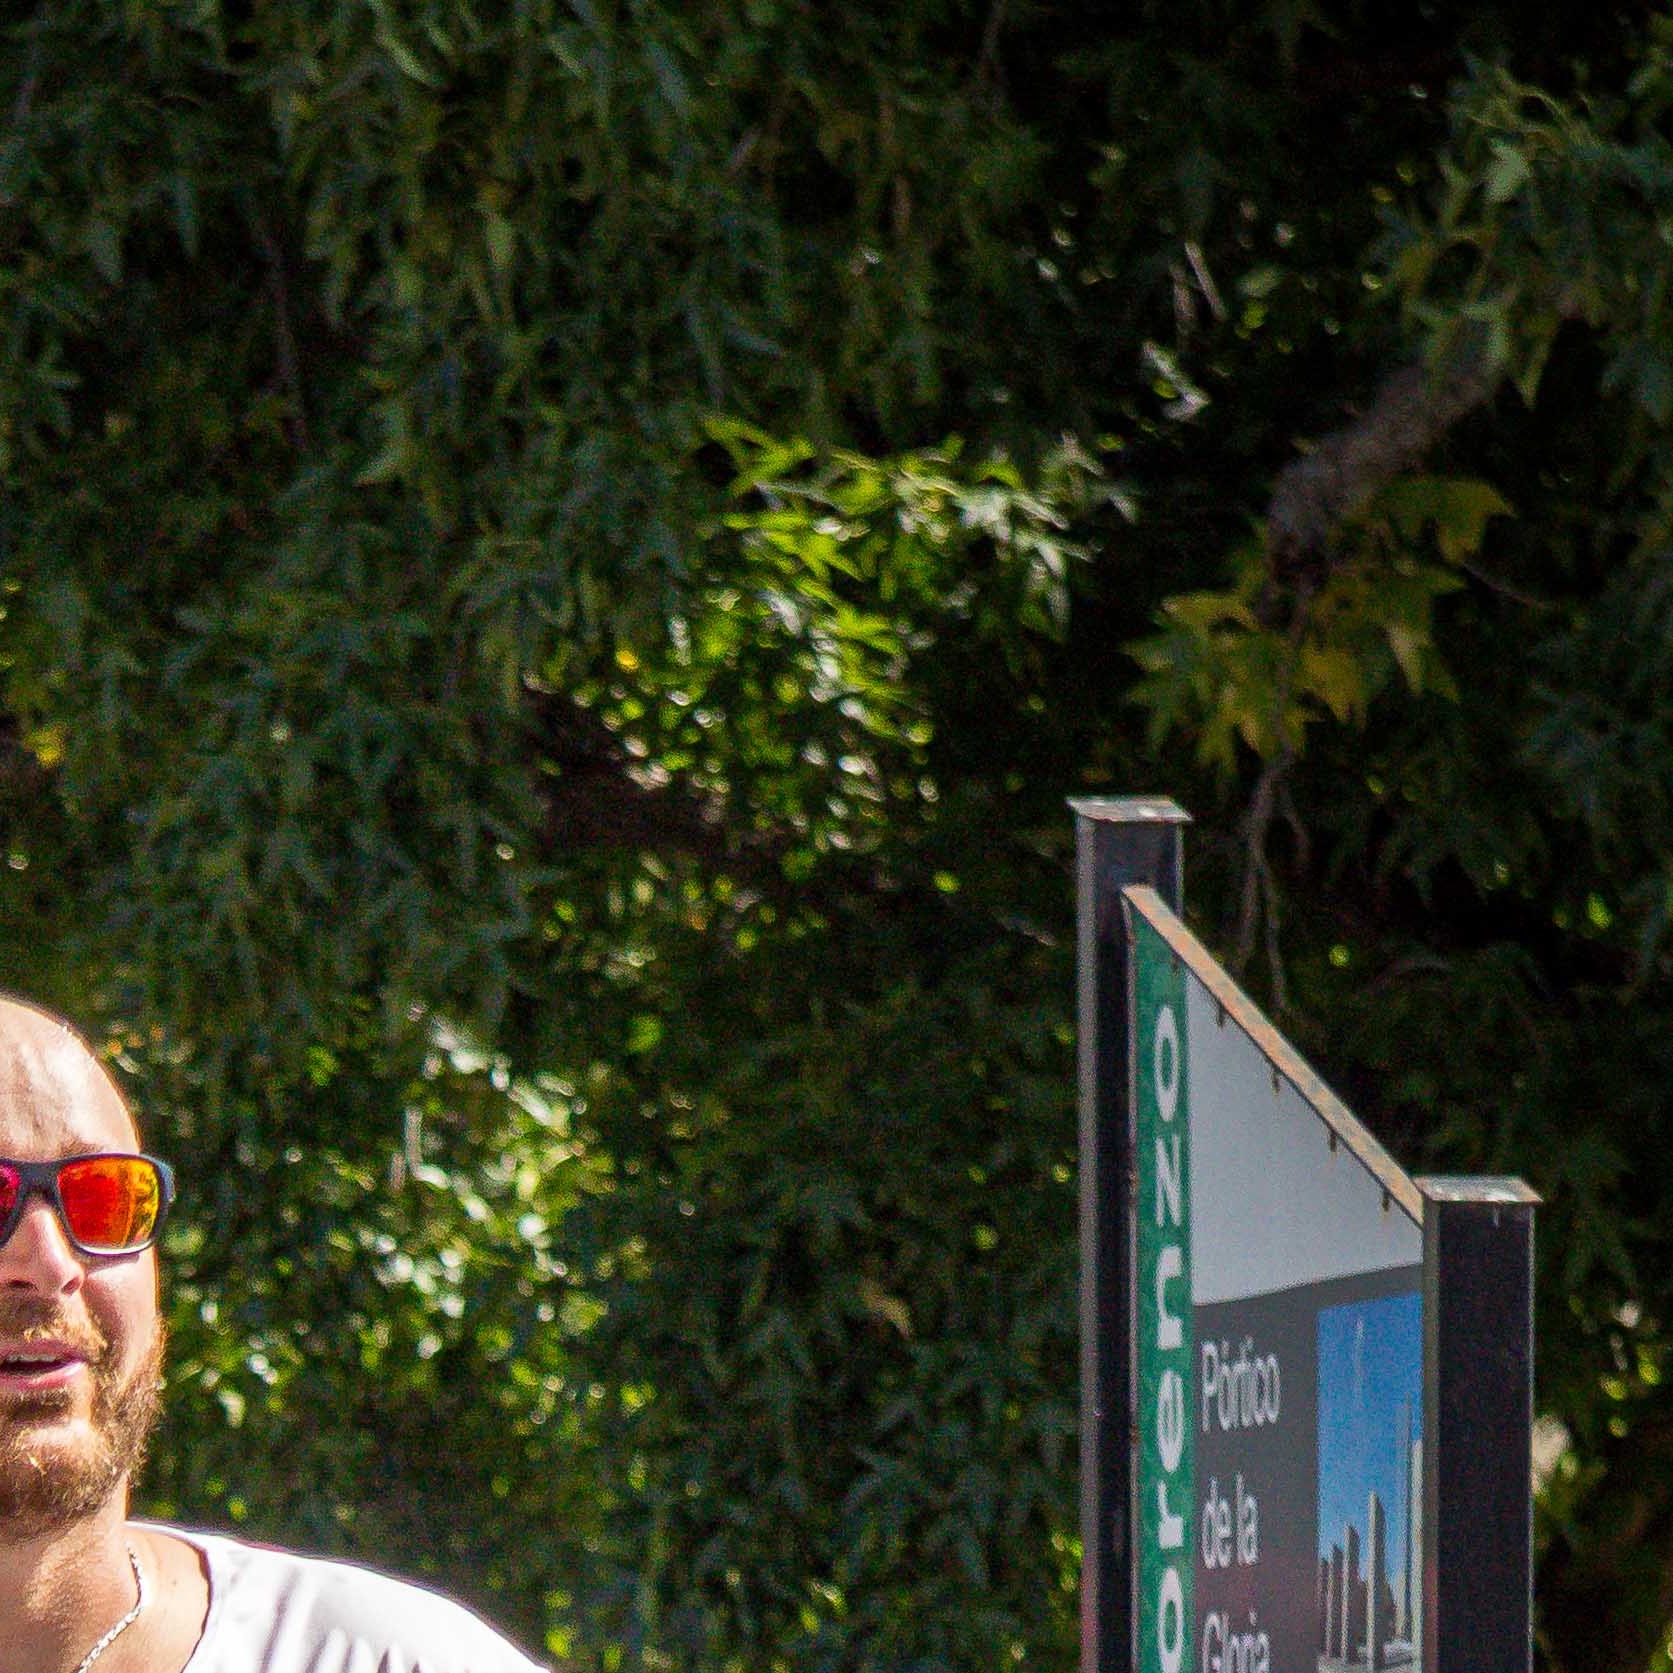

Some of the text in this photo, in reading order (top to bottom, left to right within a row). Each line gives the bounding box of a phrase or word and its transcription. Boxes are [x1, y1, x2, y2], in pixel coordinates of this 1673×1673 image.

[1201, 1336, 1281, 1432] Pórtico
[1201, 1471, 1259, 1570] de la
